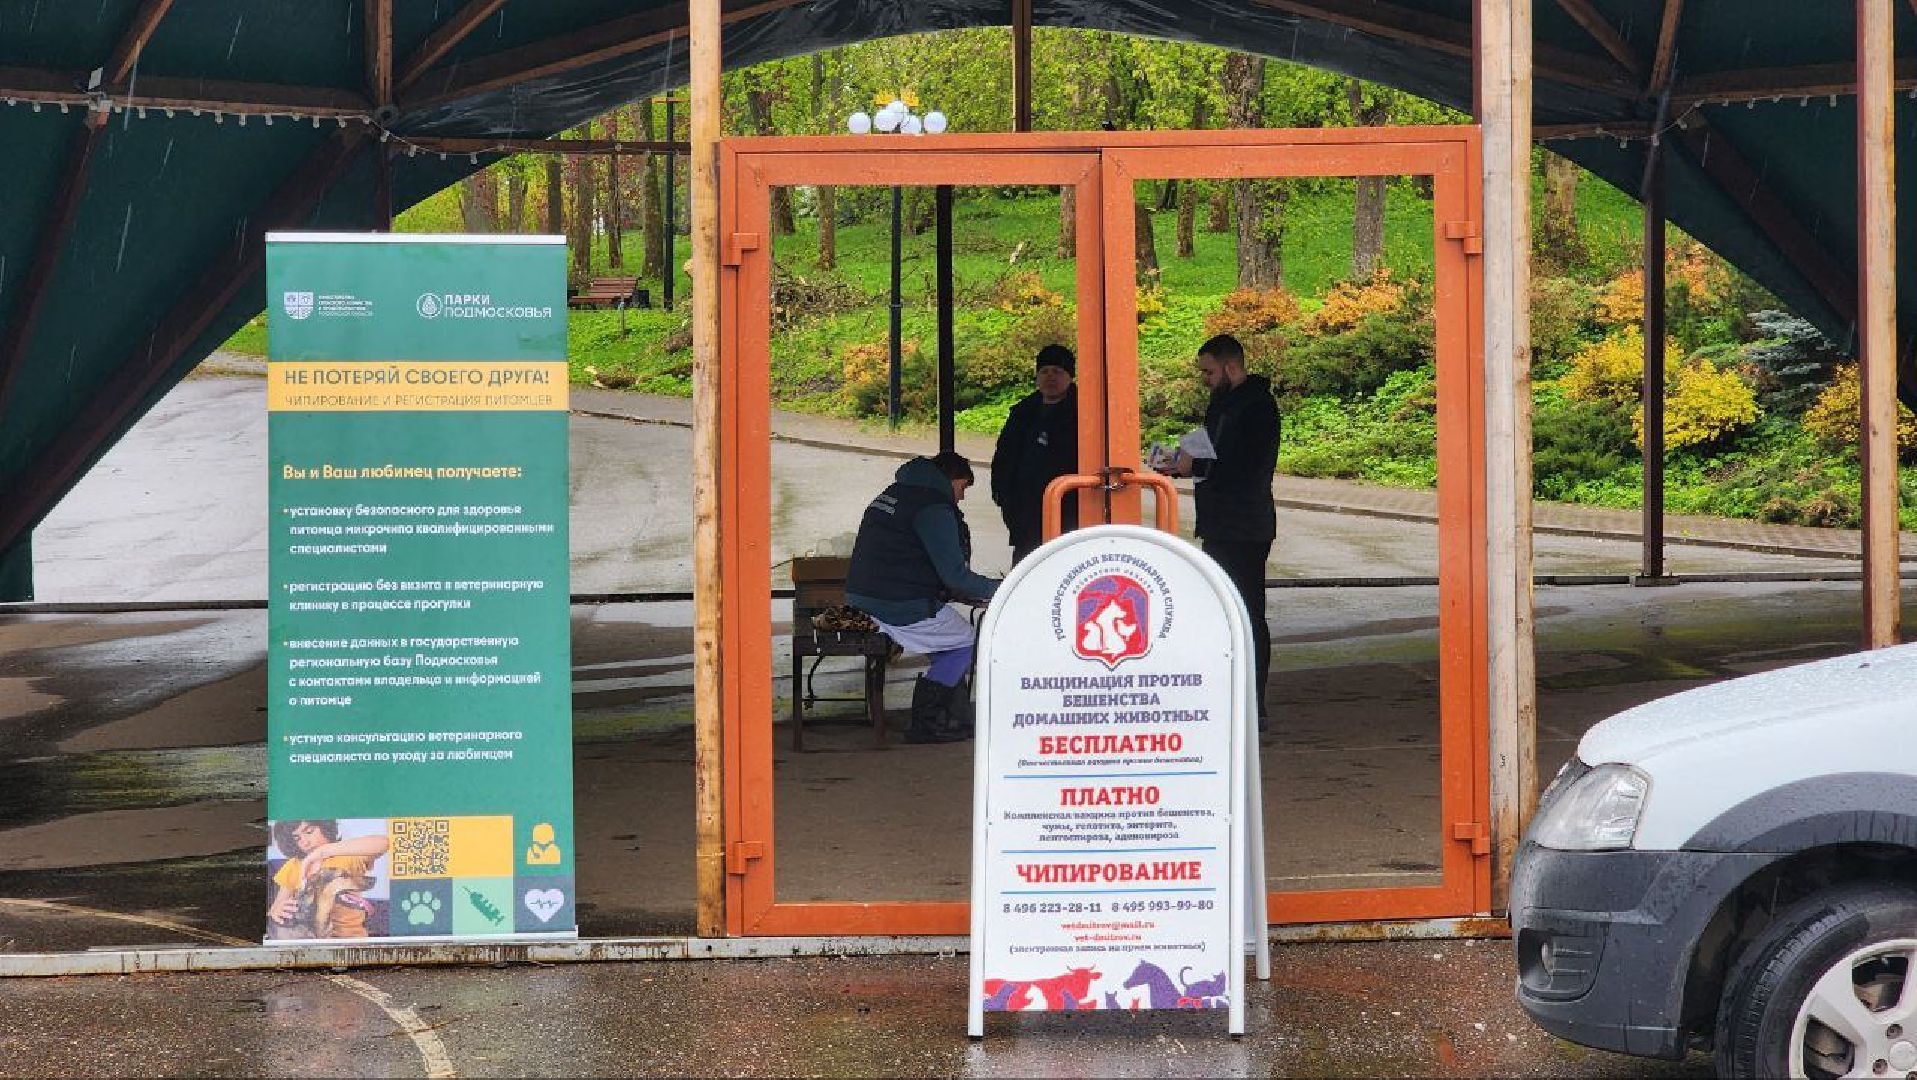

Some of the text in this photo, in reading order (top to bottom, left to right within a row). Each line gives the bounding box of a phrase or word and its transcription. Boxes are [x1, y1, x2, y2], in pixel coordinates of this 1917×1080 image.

[444, 294, 490, 305] ПАРКИ
[444, 306, 552, 318] ПОДМОСКОВЬЯ
[285, 365, 549, 386] НЕ ПОТЕРЯЙ СВОЕГО ДРУГА!
[285, 394, 553, 407] ЧИПИРОВАНИЕ И РЕГИСТРАЦИЯ ПИТОМЦЕВ
[283, 465, 522, 481] Вы и Ваш любимец получаете:
[290, 504, 522, 519] установку безопасного для здоровья
[290, 522, 554, 537] питомца микрочипа квалифицированными
[290, 543, 387, 555] специалистами
[1101, 553, 1170, 596] ВЕТЕРИНАРНАЯ
[290, 579, 544, 594] регистрацию без визита в ветеринарную
[290, 599, 471, 612] клинику в процессе прогулки
[290, 636, 519, 649] внесение данных в государственную
[290, 654, 498, 670] региональную базу Подмосковья
[289, 672, 541, 687] с контактами владельца и информацией
[1021, 674, 1203, 692] ВАКЦИНАЦИЯ ПРОТИВ
[289, 696, 352, 706] о питомце
[1062, 693, 1161, 708] БЕШЕНСТВА
[1012, 709, 1209, 729] ДОМАШНИХ ЖИВОТНЫХ
[290, 730, 522, 745] устную консультацию ветеринарного
[1039, 733, 1182, 755] БЕСПЛАТНО
[290, 749, 513, 763] специалиста по уходу за любимцем
[1060, 786, 1160, 806] ПЛАТНО
[1074, 811, 1116, 820] вакцина
[1118, 810, 1155, 820] против
[1016, 861, 1202, 883] ЧИПИРОВАНИЕ
[1003, 900, 1214, 913] 8 496 223-28-11 8 495 993-99-80
